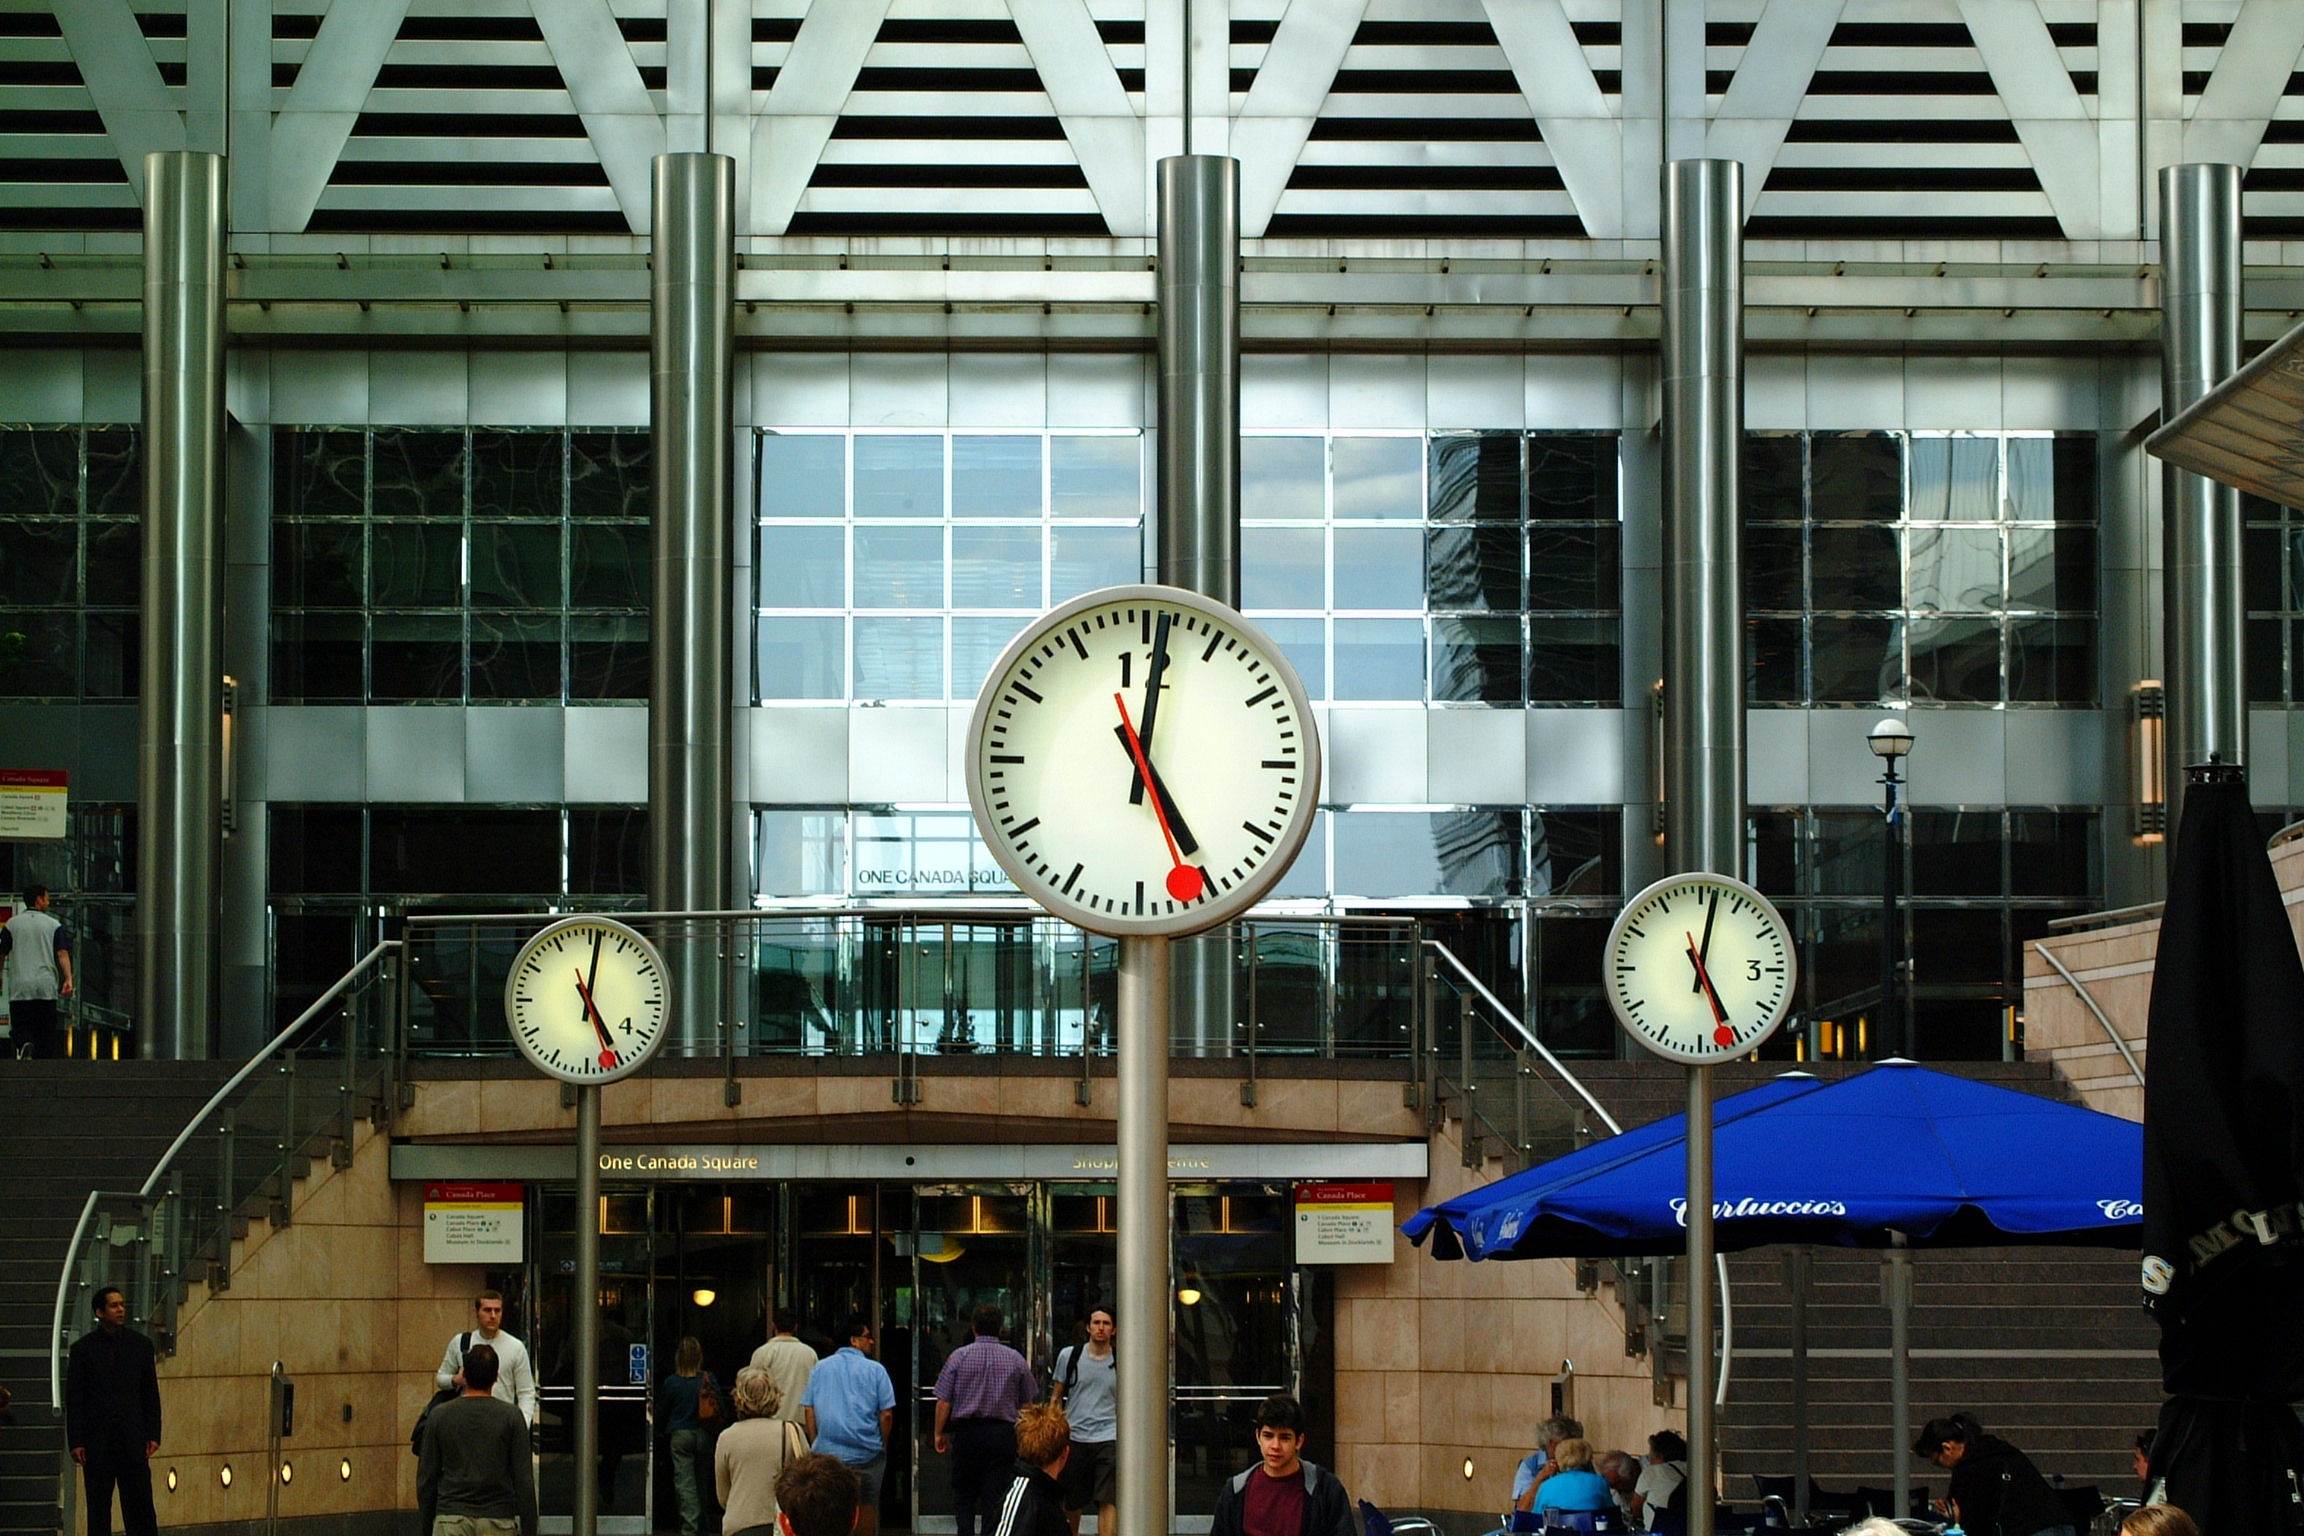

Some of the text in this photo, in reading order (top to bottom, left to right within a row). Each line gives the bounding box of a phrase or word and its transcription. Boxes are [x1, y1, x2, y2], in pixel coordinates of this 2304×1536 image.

[1118, 651, 1171, 689] 12
[859, 869, 1014, 884] ONE CANADA SQUA
[1746, 960, 1762, 981] 3
[618, 1017, 633, 1035] 4
[599, 1154, 758, 1172] One Canada Square
[1072, 1153, 1209, 1170] Shop entre
[446, 1191, 496, 1199] Canada Place
[1316, 1191, 1367, 1199] Canada Place
[2096, 1199, 2144, 1220] Ca
